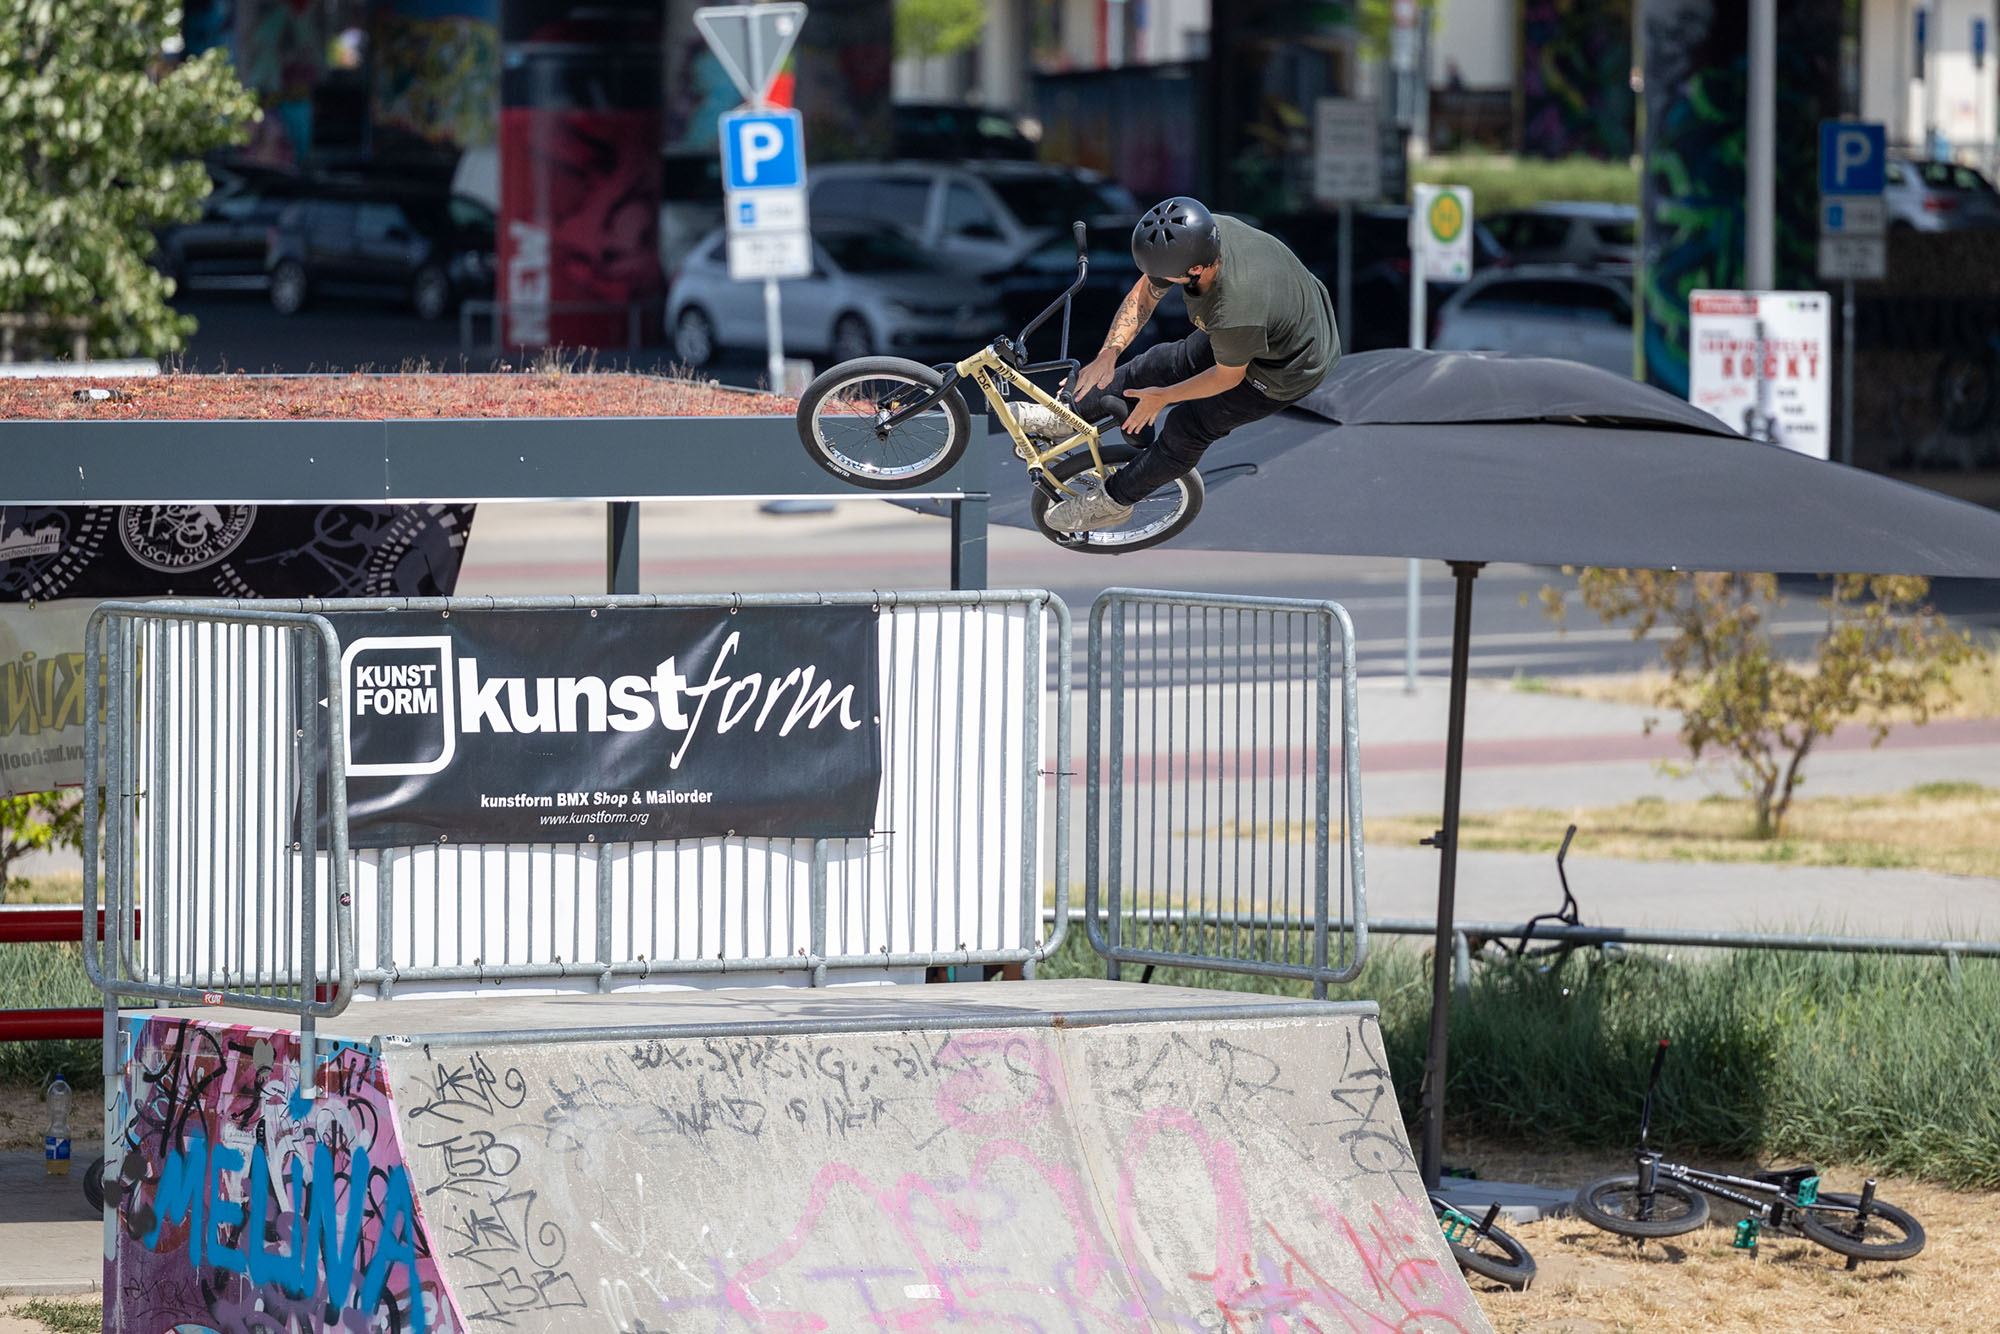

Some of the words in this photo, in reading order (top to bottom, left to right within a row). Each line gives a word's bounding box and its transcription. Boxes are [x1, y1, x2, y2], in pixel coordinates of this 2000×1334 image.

[739, 121, 784, 184] P
[1836, 130, 1873, 186] P
[128, 517, 149, 551] BMX
[144, 545, 215, 566] SCHOOL
[217, 505, 249, 548] BERLIN
[356, 664, 437, 688] KUNST
[356, 687, 438, 716] FORM
[458, 631, 862, 770] kunstform
[480, 793, 553, 808] kunstform
[556, 792, 590, 807] BMX
[593, 791, 628, 808] Shop
[631, 790, 642, 805] &
[646, 789, 713, 804] Mailorder
[540, 810, 650, 825] www.kunstform.org
